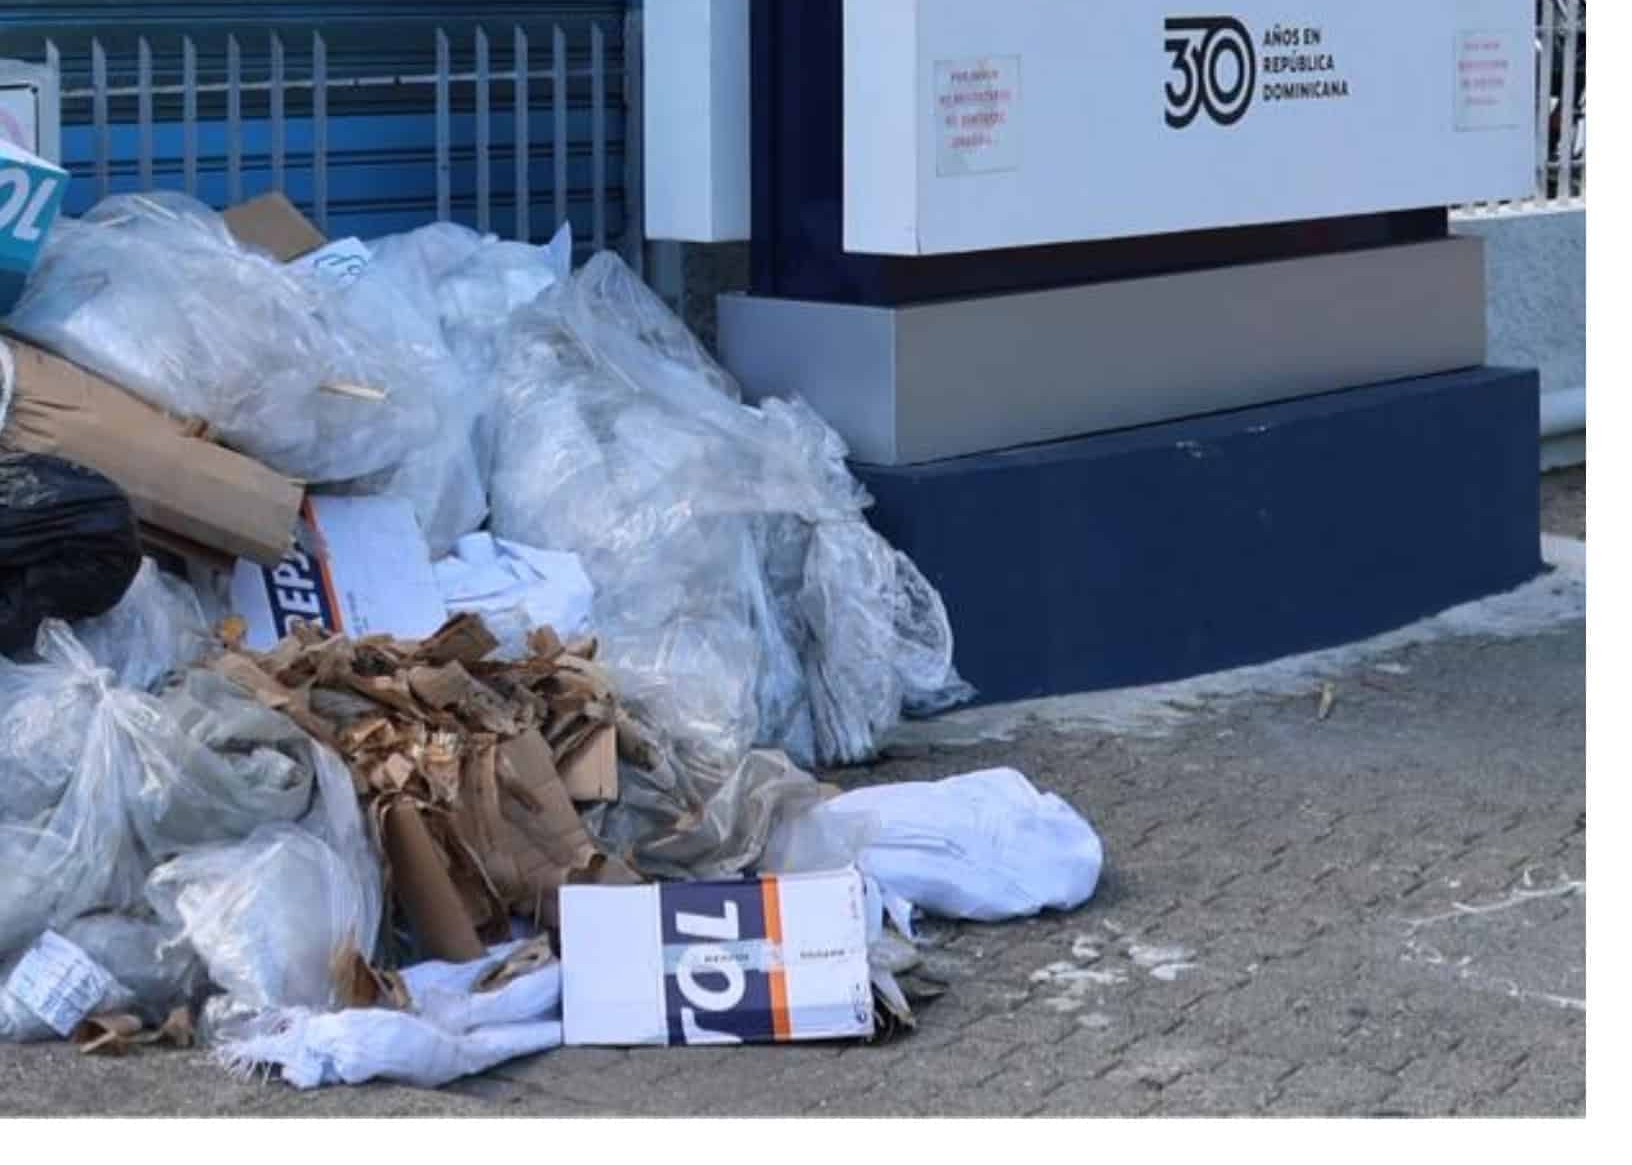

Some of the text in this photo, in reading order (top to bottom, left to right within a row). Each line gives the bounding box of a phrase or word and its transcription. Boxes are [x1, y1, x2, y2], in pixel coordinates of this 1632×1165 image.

[1263, 24, 1321, 46] AÑOS EN
[1165, 16, 1256, 129] 30
[1263, 51, 1335, 73] REPÚBLICA
[1263, 80, 1350, 101] DOMINICANA
